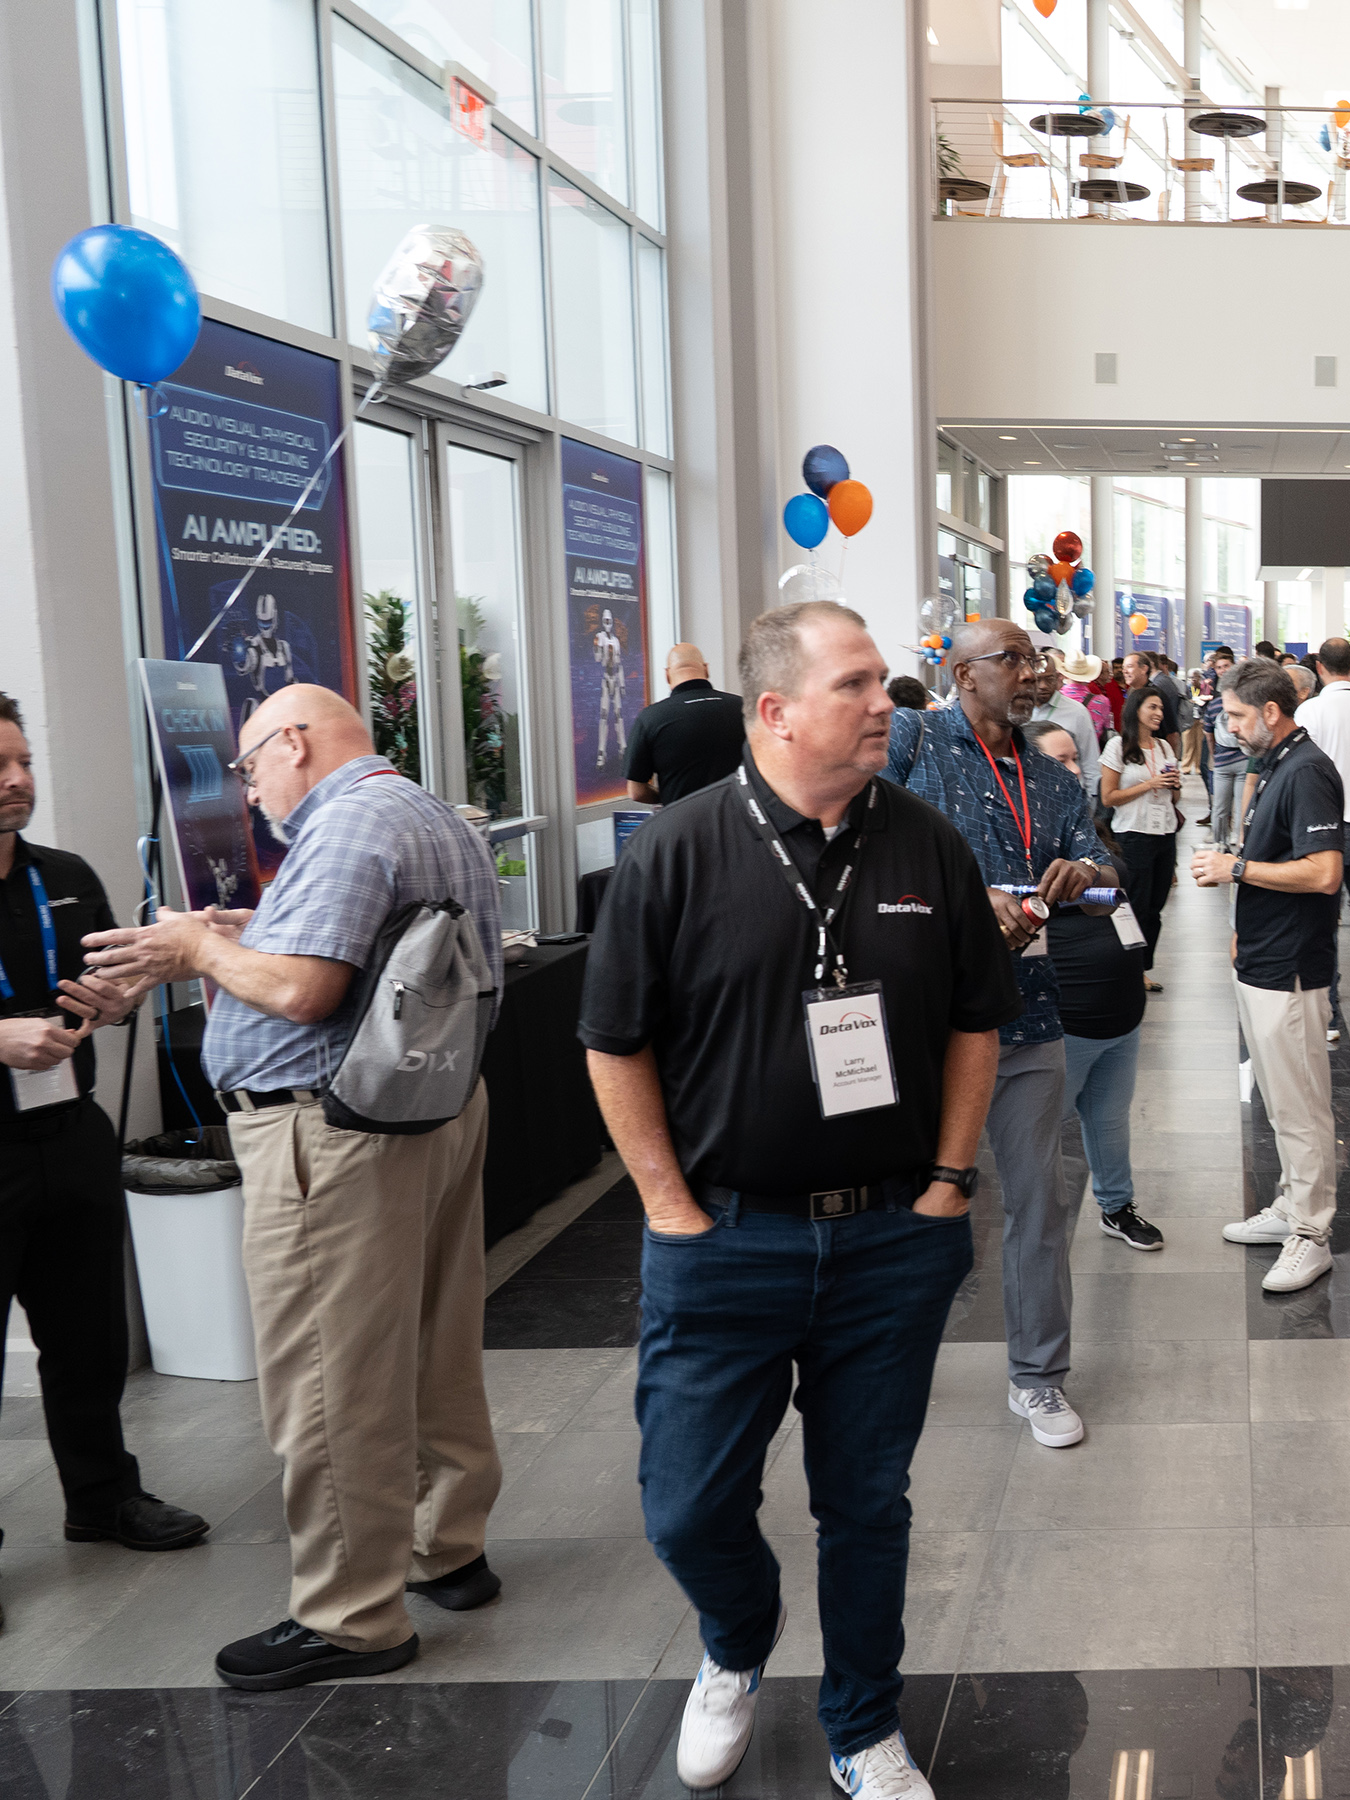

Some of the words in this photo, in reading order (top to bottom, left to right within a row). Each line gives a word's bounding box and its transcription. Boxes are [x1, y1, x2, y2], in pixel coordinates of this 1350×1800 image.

[182, 513, 209, 542] AI
[210, 517, 323, 554] AMPLIFIED:
[878, 902, 933, 915] DataVox
[820, 1018, 878, 1036] DataVox
[844, 1057, 866, 1067] Larry
[835, 1064, 878, 1078] McMichael
[833, 1078, 857, 1088] Account
[857, 1073, 883, 1084] Manager
